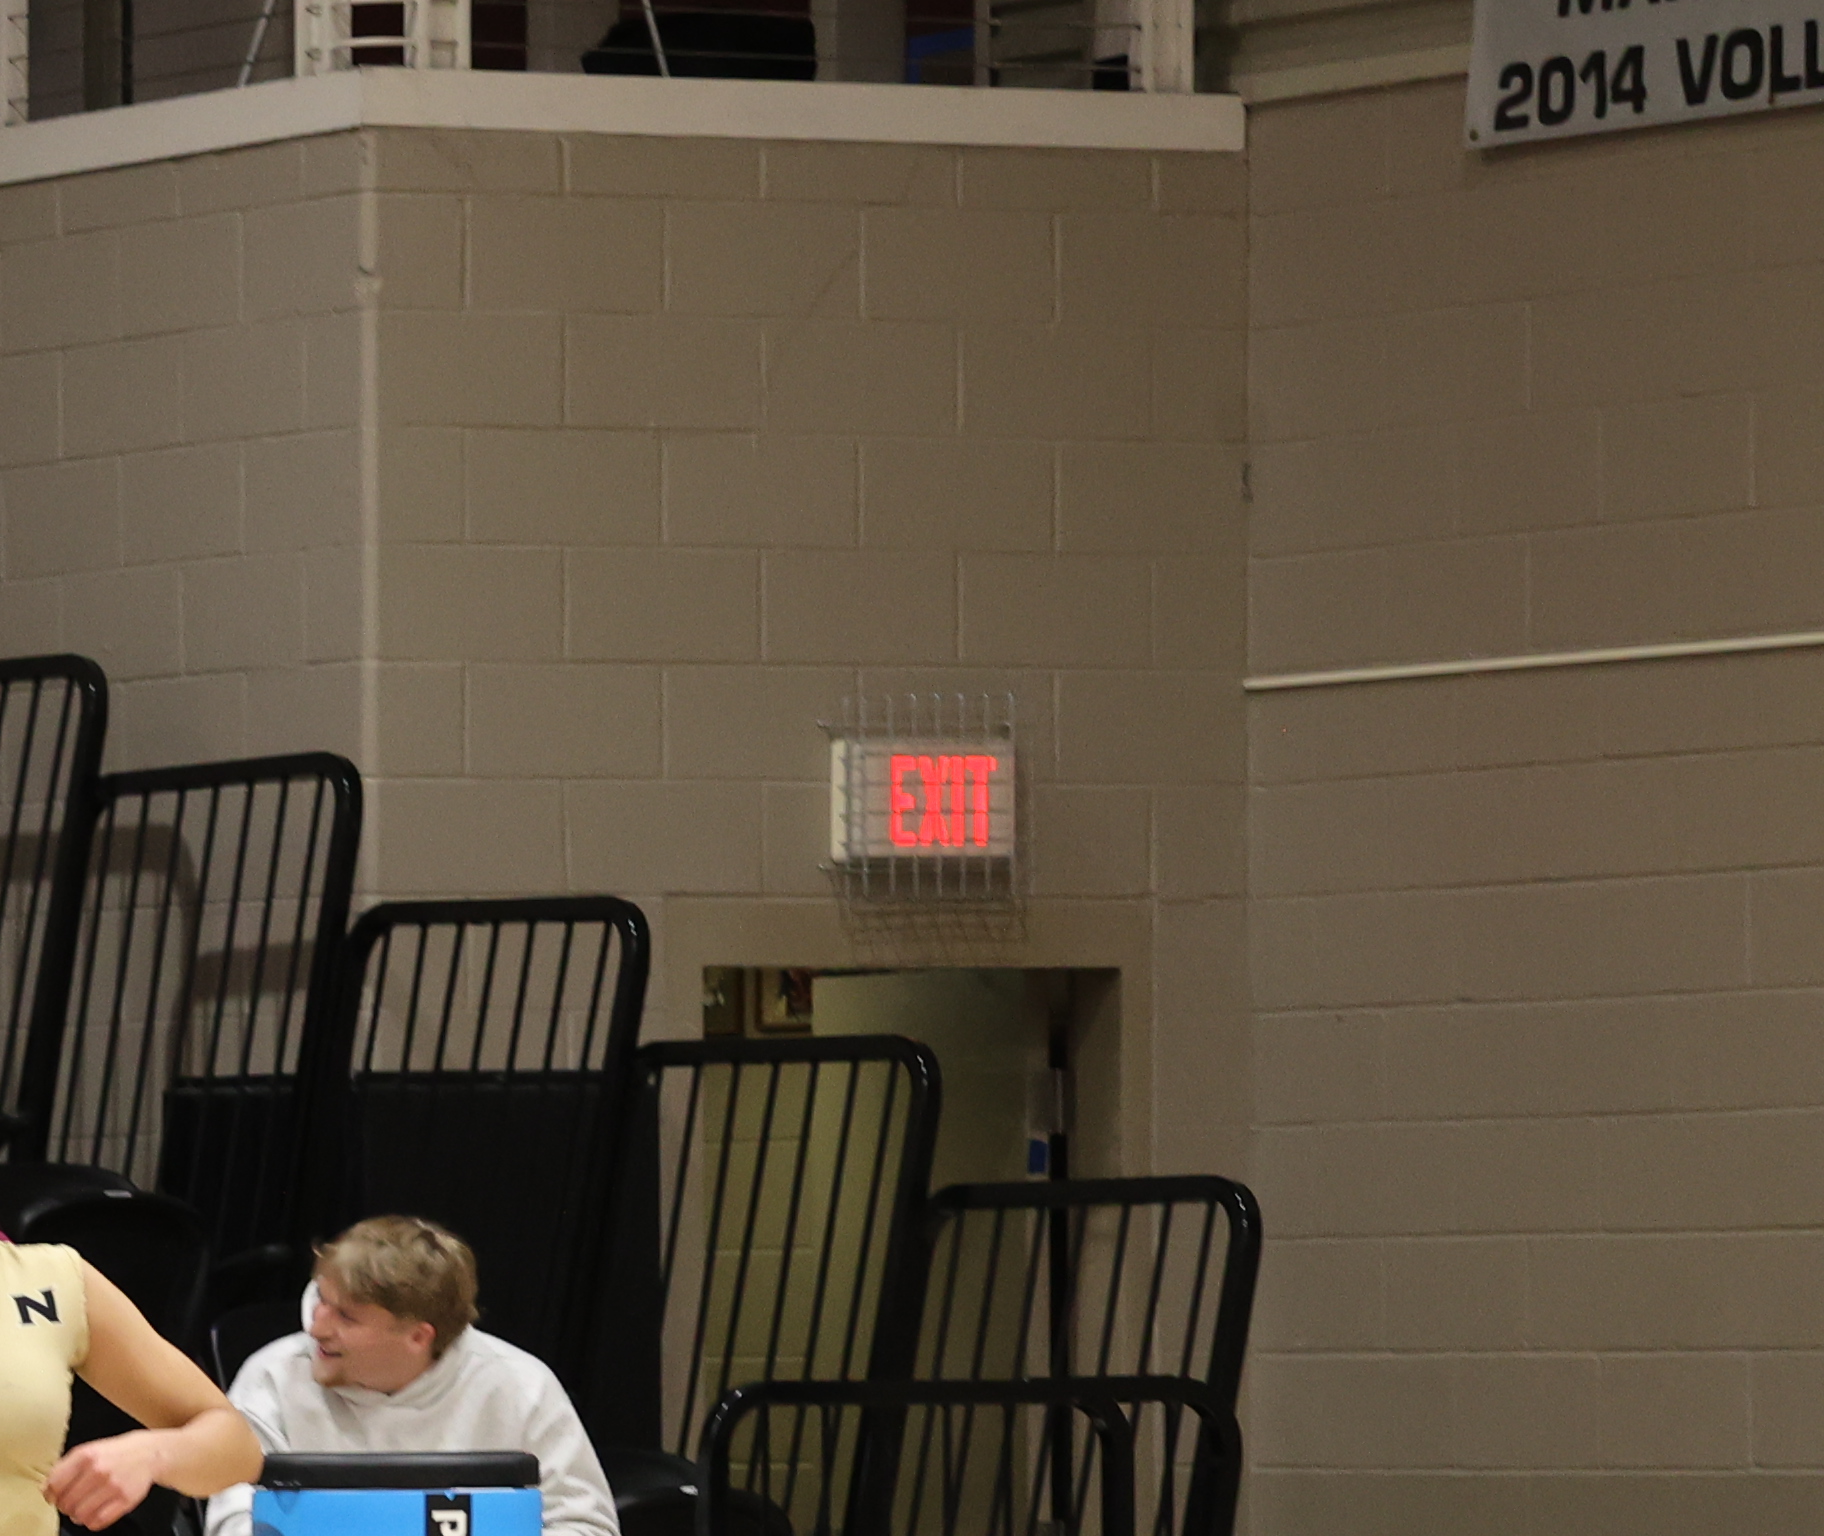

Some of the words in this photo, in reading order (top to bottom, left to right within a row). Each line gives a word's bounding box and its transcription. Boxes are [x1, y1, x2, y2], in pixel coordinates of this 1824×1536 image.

[1494, 46, 1647, 131] 2014
[890, 754, 998, 847] EXIT
[13, 1287, 62, 1326] N
